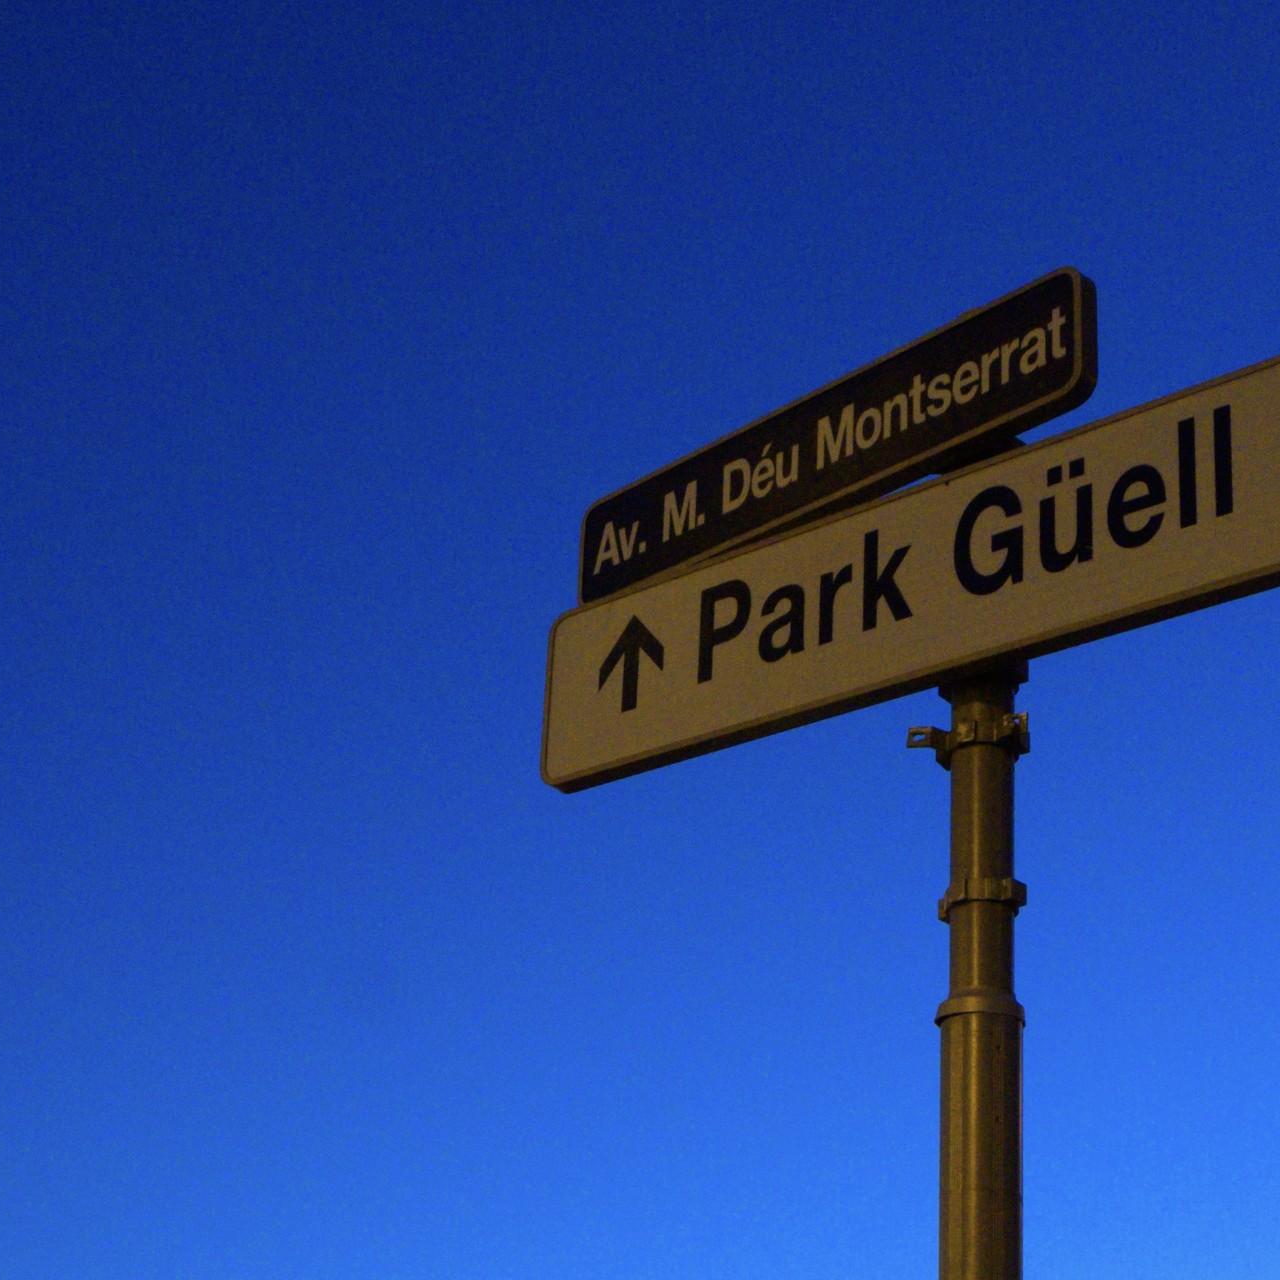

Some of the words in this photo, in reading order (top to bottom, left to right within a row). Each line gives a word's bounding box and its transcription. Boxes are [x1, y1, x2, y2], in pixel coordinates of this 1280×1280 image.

[593, 516, 646, 576] Av.
[662, 480, 706, 543] M.
[721, 440, 799, 515] Déu
[816, 304, 1067, 472] Montserrat
[697, 529, 914, 685] Park
[953, 403, 1234, 597] Güell
